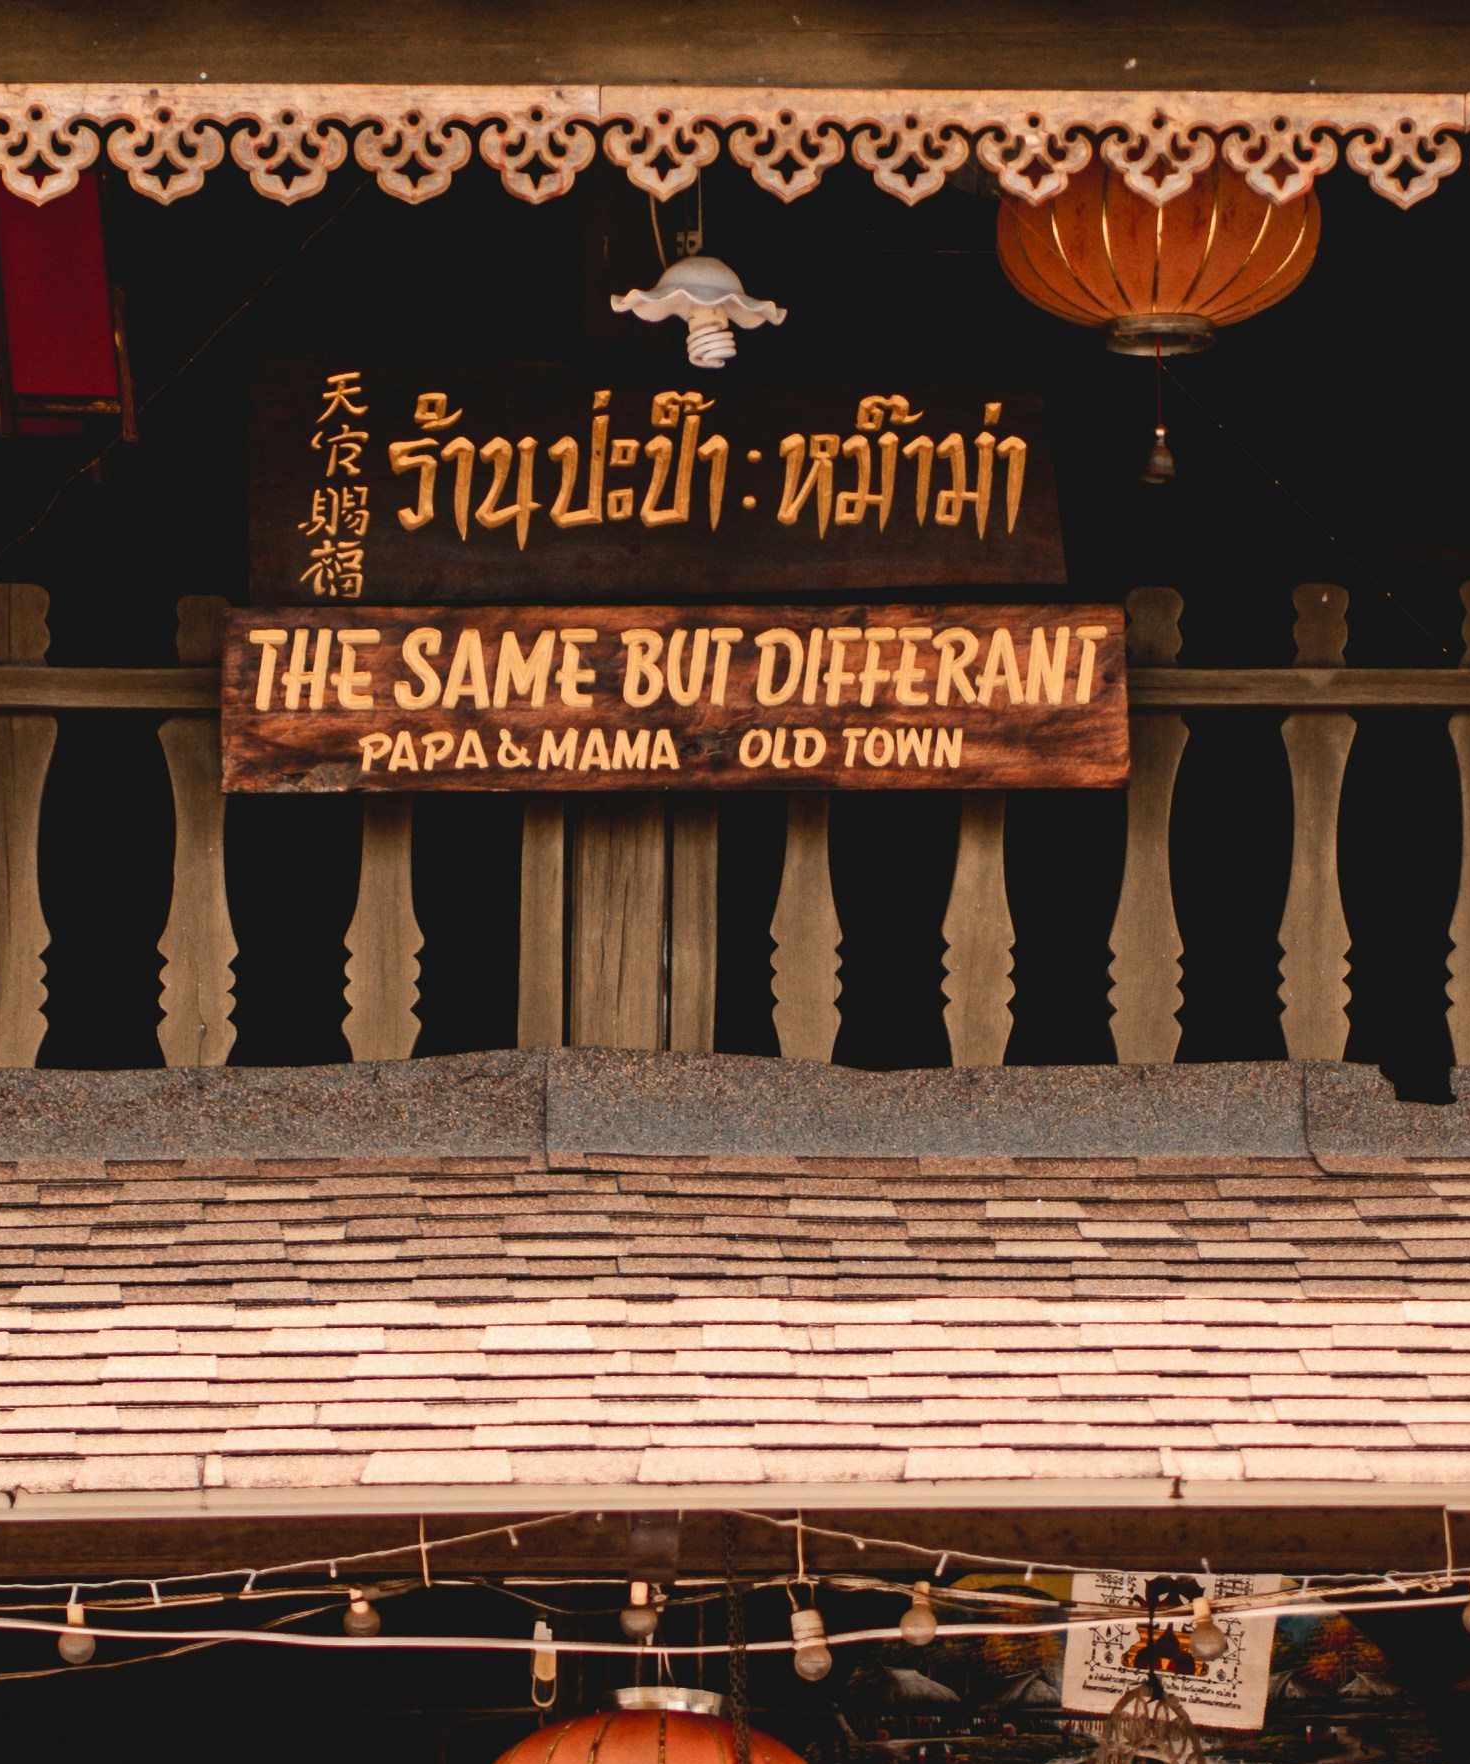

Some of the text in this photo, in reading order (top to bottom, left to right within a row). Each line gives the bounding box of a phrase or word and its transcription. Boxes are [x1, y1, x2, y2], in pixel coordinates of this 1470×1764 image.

[249, 626, 1108, 711] THE SAME BUT DIFFERANT
[738, 727, 827, 769] OLD
[842, 727, 964, 769] TOWN
